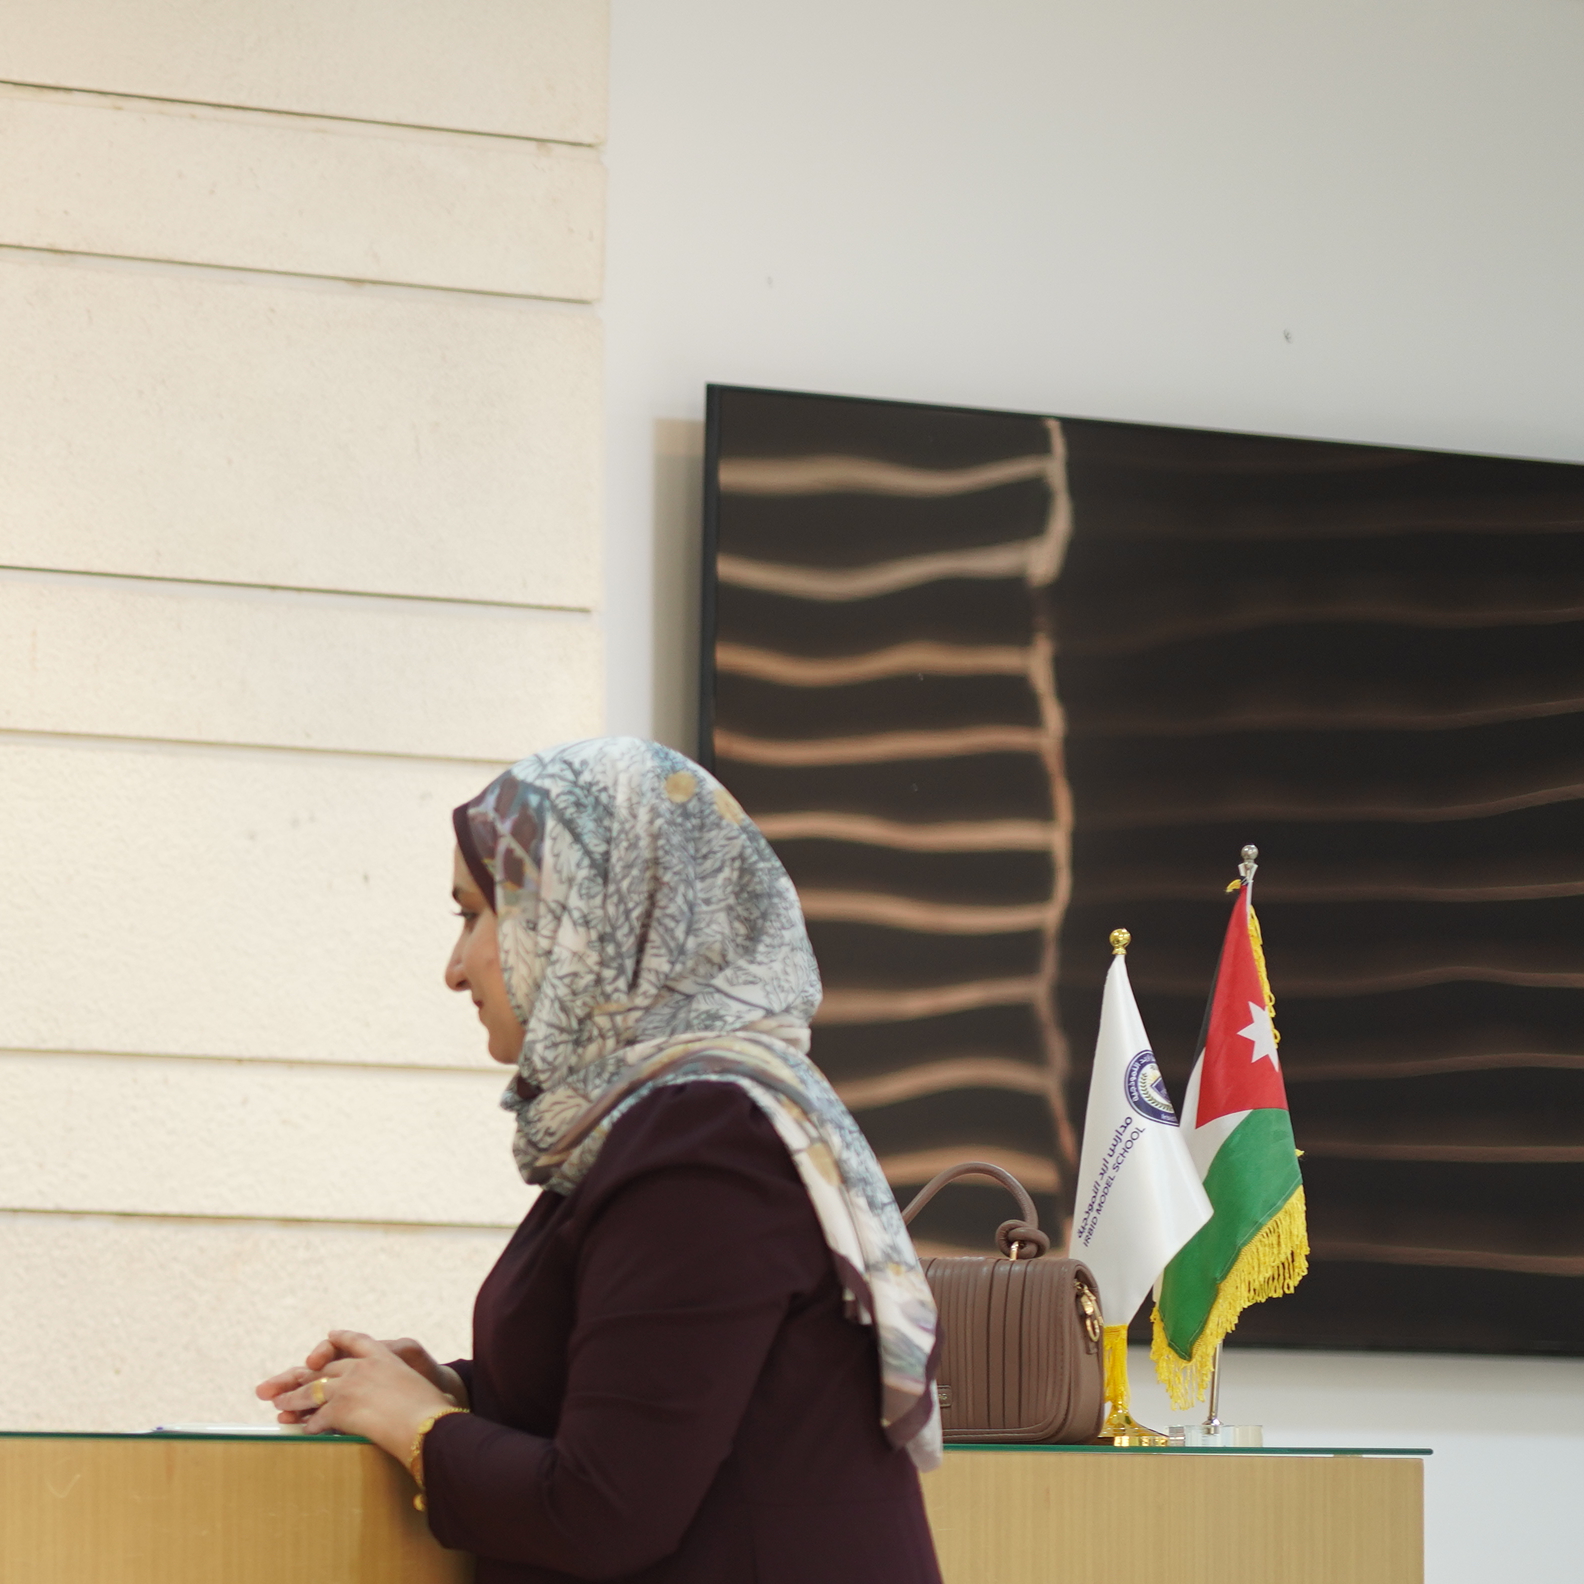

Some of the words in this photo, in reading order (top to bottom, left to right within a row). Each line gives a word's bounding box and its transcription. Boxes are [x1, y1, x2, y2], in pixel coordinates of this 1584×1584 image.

[1108, 1116, 1133, 1158] مدارس
[1077, 1180, 1100, 1240] النموذجية
[1083, 1216, 1098, 1247] IRBID
[1096, 1174, 1116, 1215] MODEL
[1113, 1127, 1146, 1172] SCHOOL
